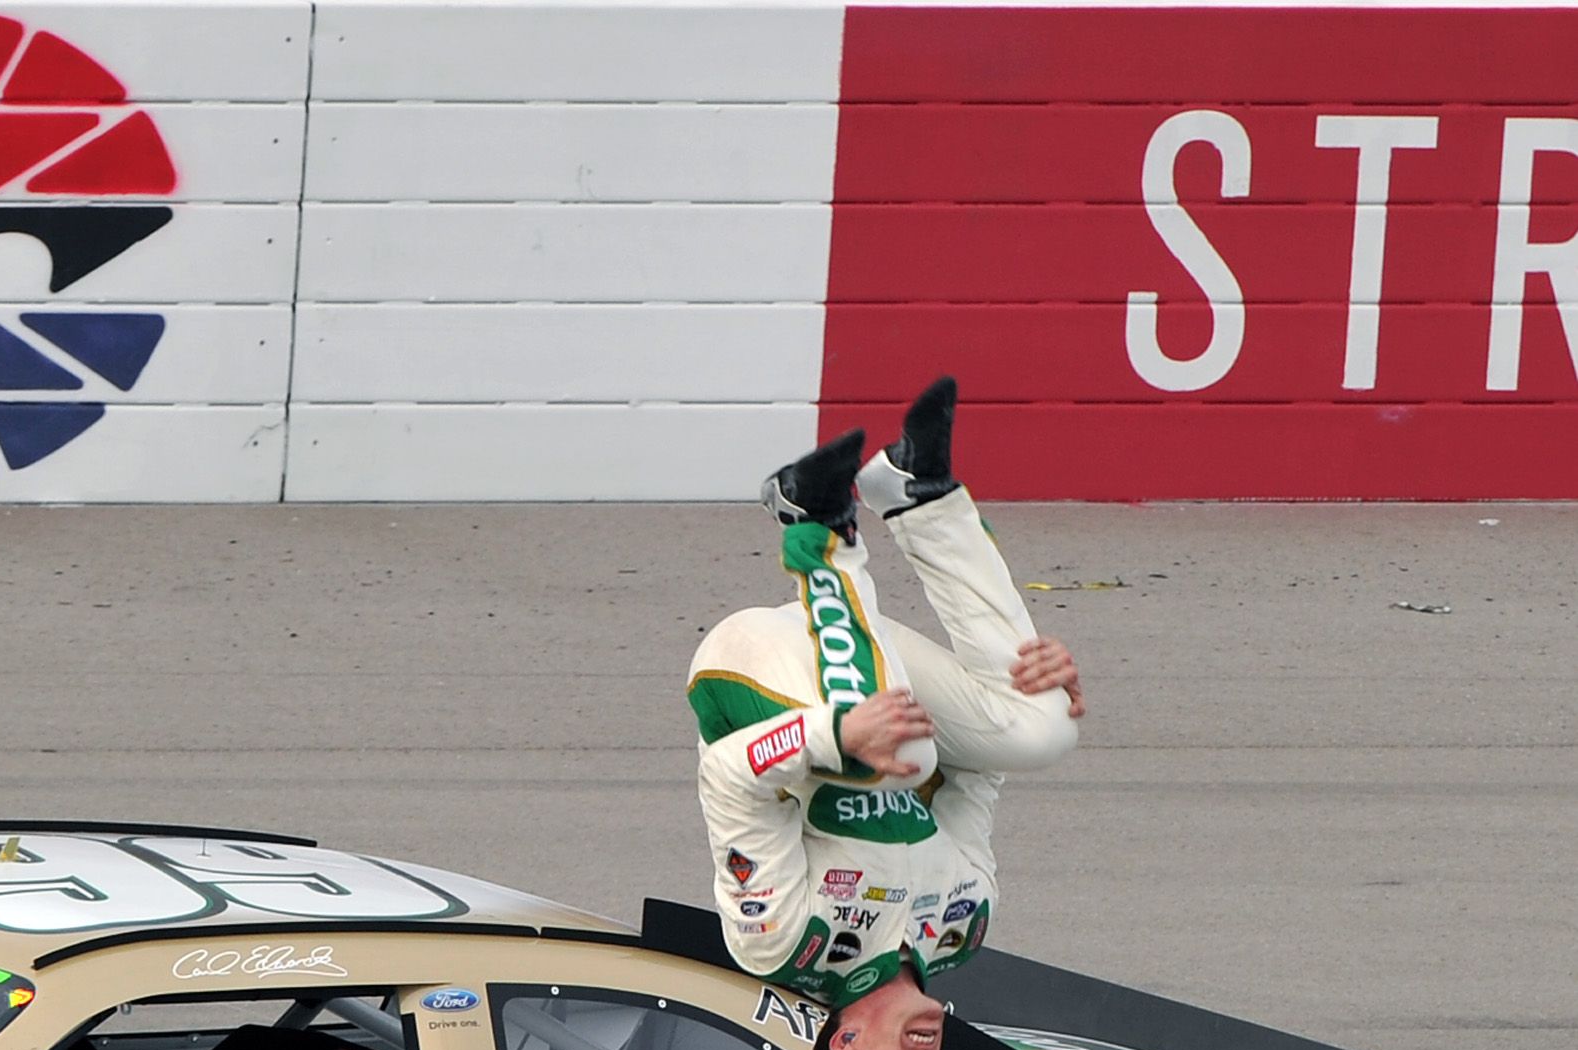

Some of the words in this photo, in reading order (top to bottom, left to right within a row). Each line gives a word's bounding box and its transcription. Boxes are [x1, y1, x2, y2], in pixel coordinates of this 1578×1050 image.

[809, 568, 867, 705] Scott
[753, 720, 802, 766] ORTHO
[835, 788, 930, 823] Scotts
[432, 991, 469, 1009] Ford
[428, 1020, 458, 1030] Drive
